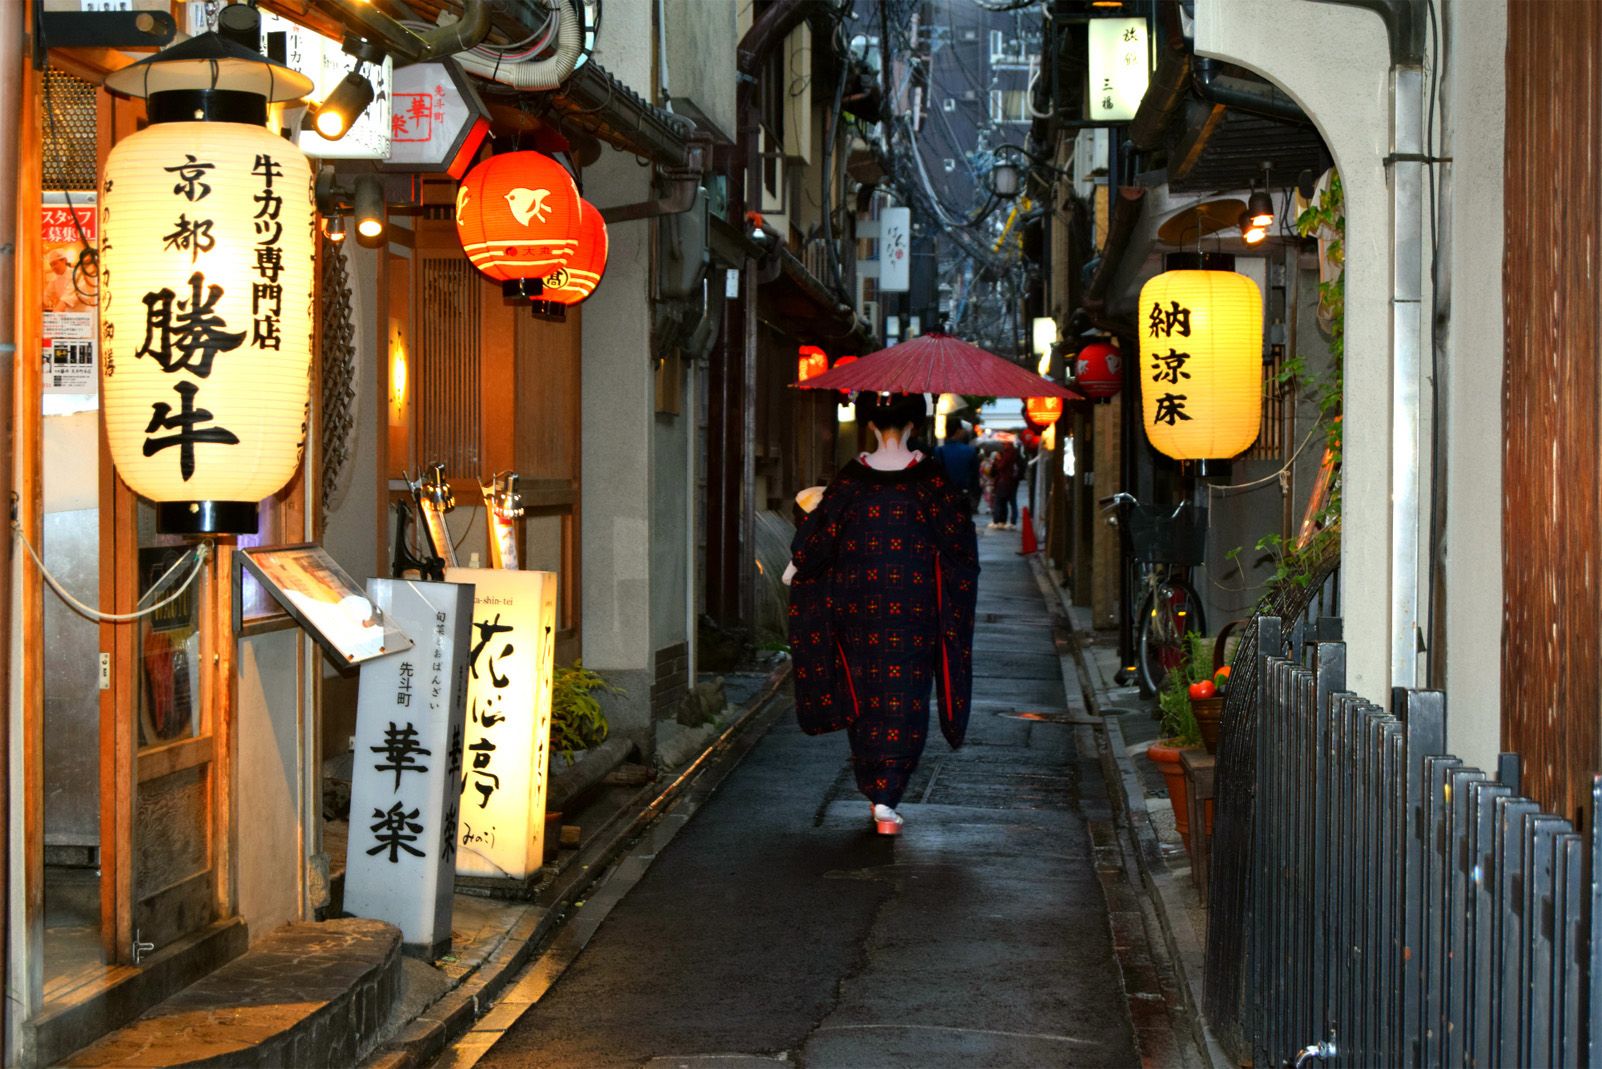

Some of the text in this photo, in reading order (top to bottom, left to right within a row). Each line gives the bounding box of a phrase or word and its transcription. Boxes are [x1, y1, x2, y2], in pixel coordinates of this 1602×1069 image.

[251, 154, 284, 351] 牛カツ専門店
[1149, 301, 1193, 426] 納涼床
[430, 611, 447, 710] 旬菜とおばんざい
[472, 594, 514, 606] a-shin-tei
[397, 662, 414, 708] 先斗町
[461, 613, 514, 809] 花心亭
[366, 722, 432, 863] 華楽
